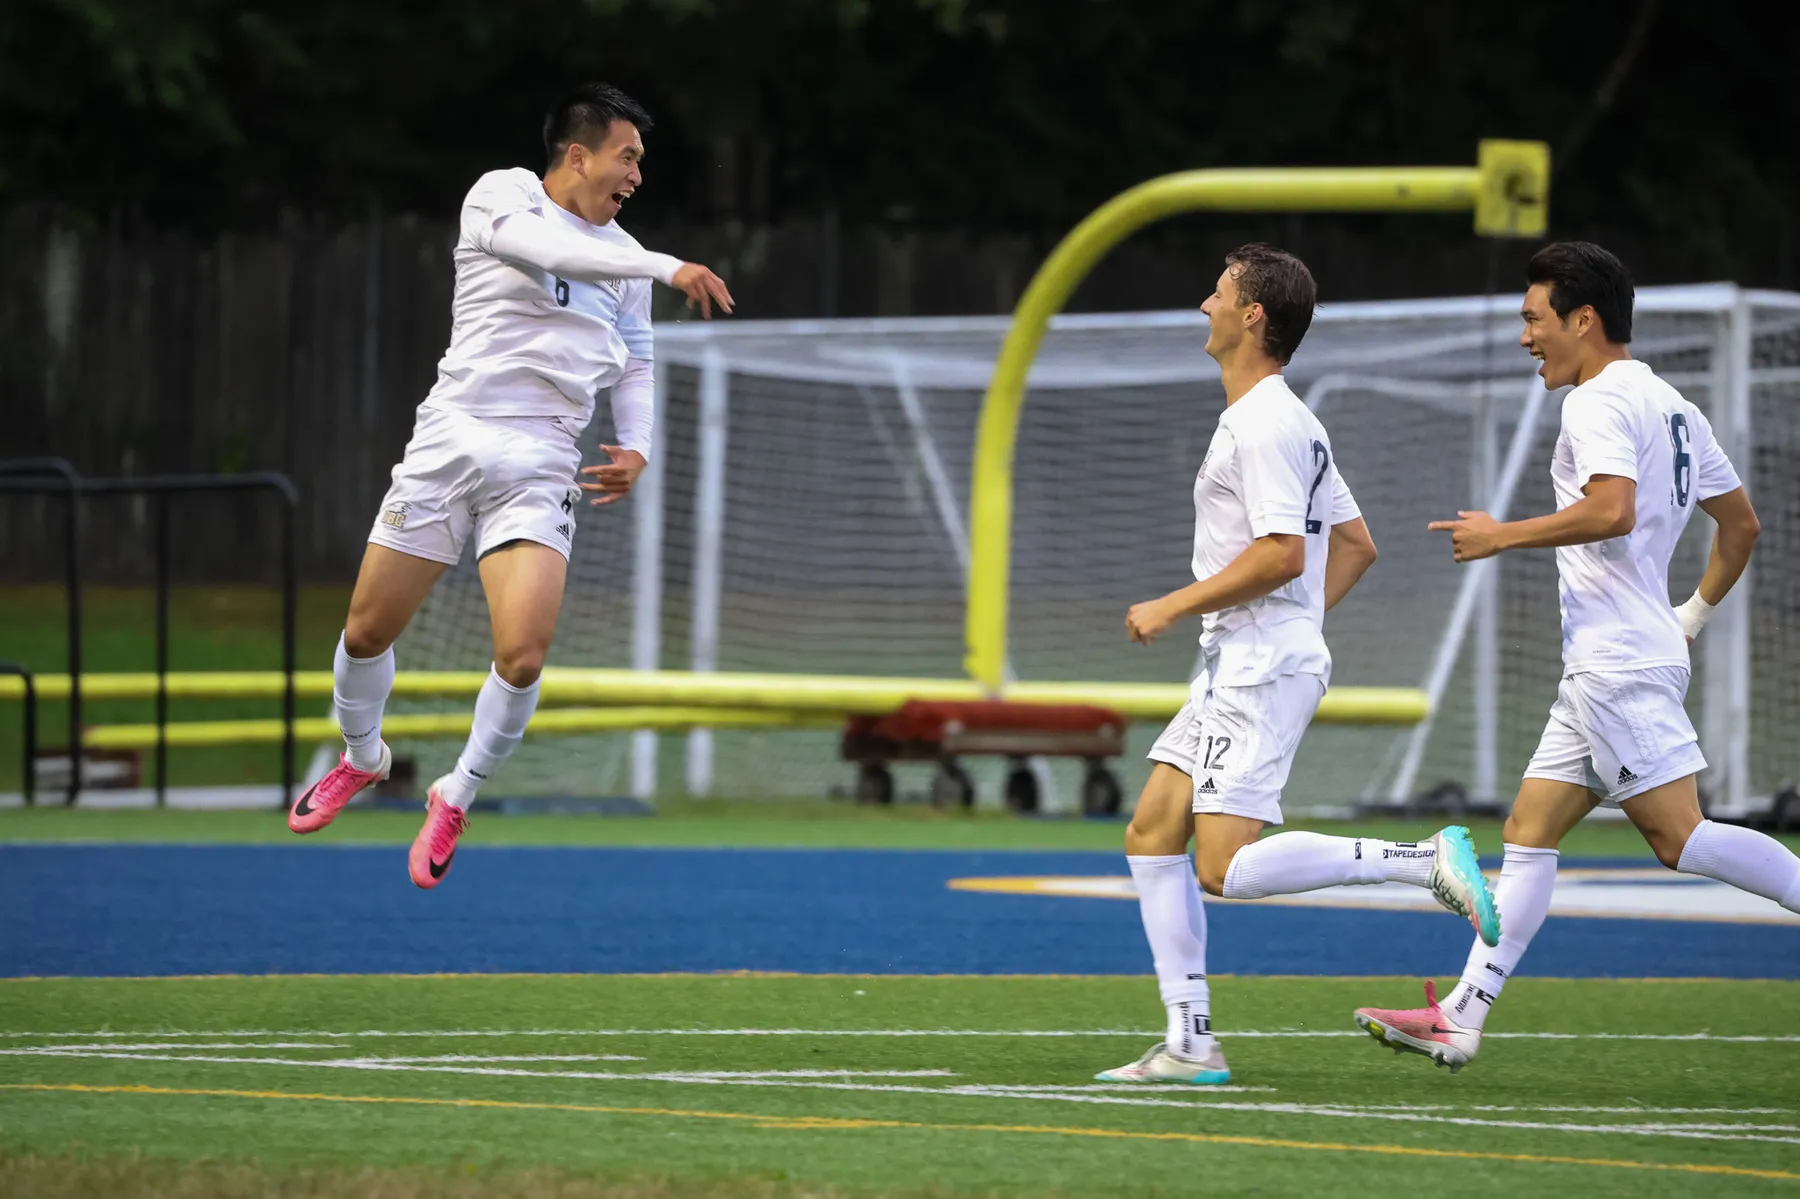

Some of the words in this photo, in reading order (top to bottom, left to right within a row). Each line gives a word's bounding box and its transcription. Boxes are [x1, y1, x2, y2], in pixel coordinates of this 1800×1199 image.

[1306, 438, 1328, 534] 2
[1663, 412, 1691, 508] 6
[1203, 735, 1231, 770] 12
[1617, 773, 1638, 786] adidas
